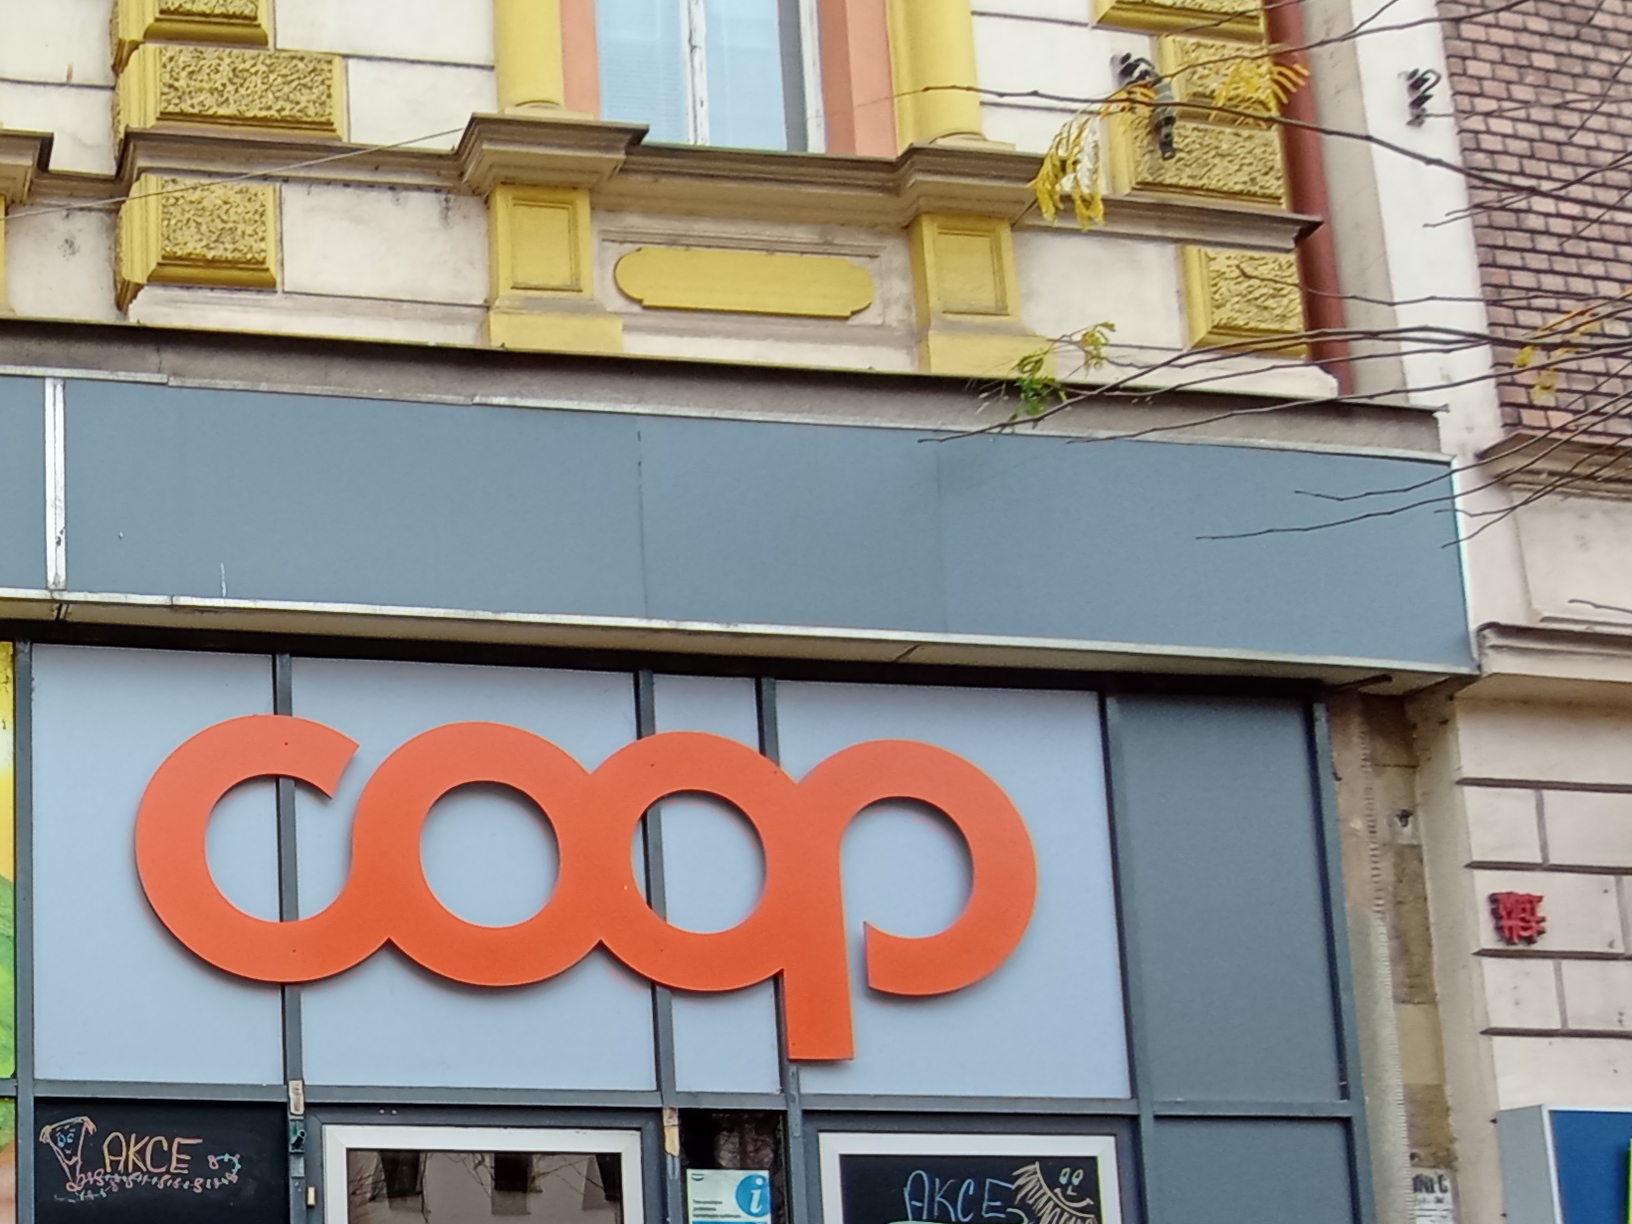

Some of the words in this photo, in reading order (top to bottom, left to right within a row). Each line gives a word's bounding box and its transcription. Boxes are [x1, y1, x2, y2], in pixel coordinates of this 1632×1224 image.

[135, 714, 1038, 1061] coop
[101, 1131, 204, 1175] AKCE
[903, 1170, 1015, 1222] AKCE
